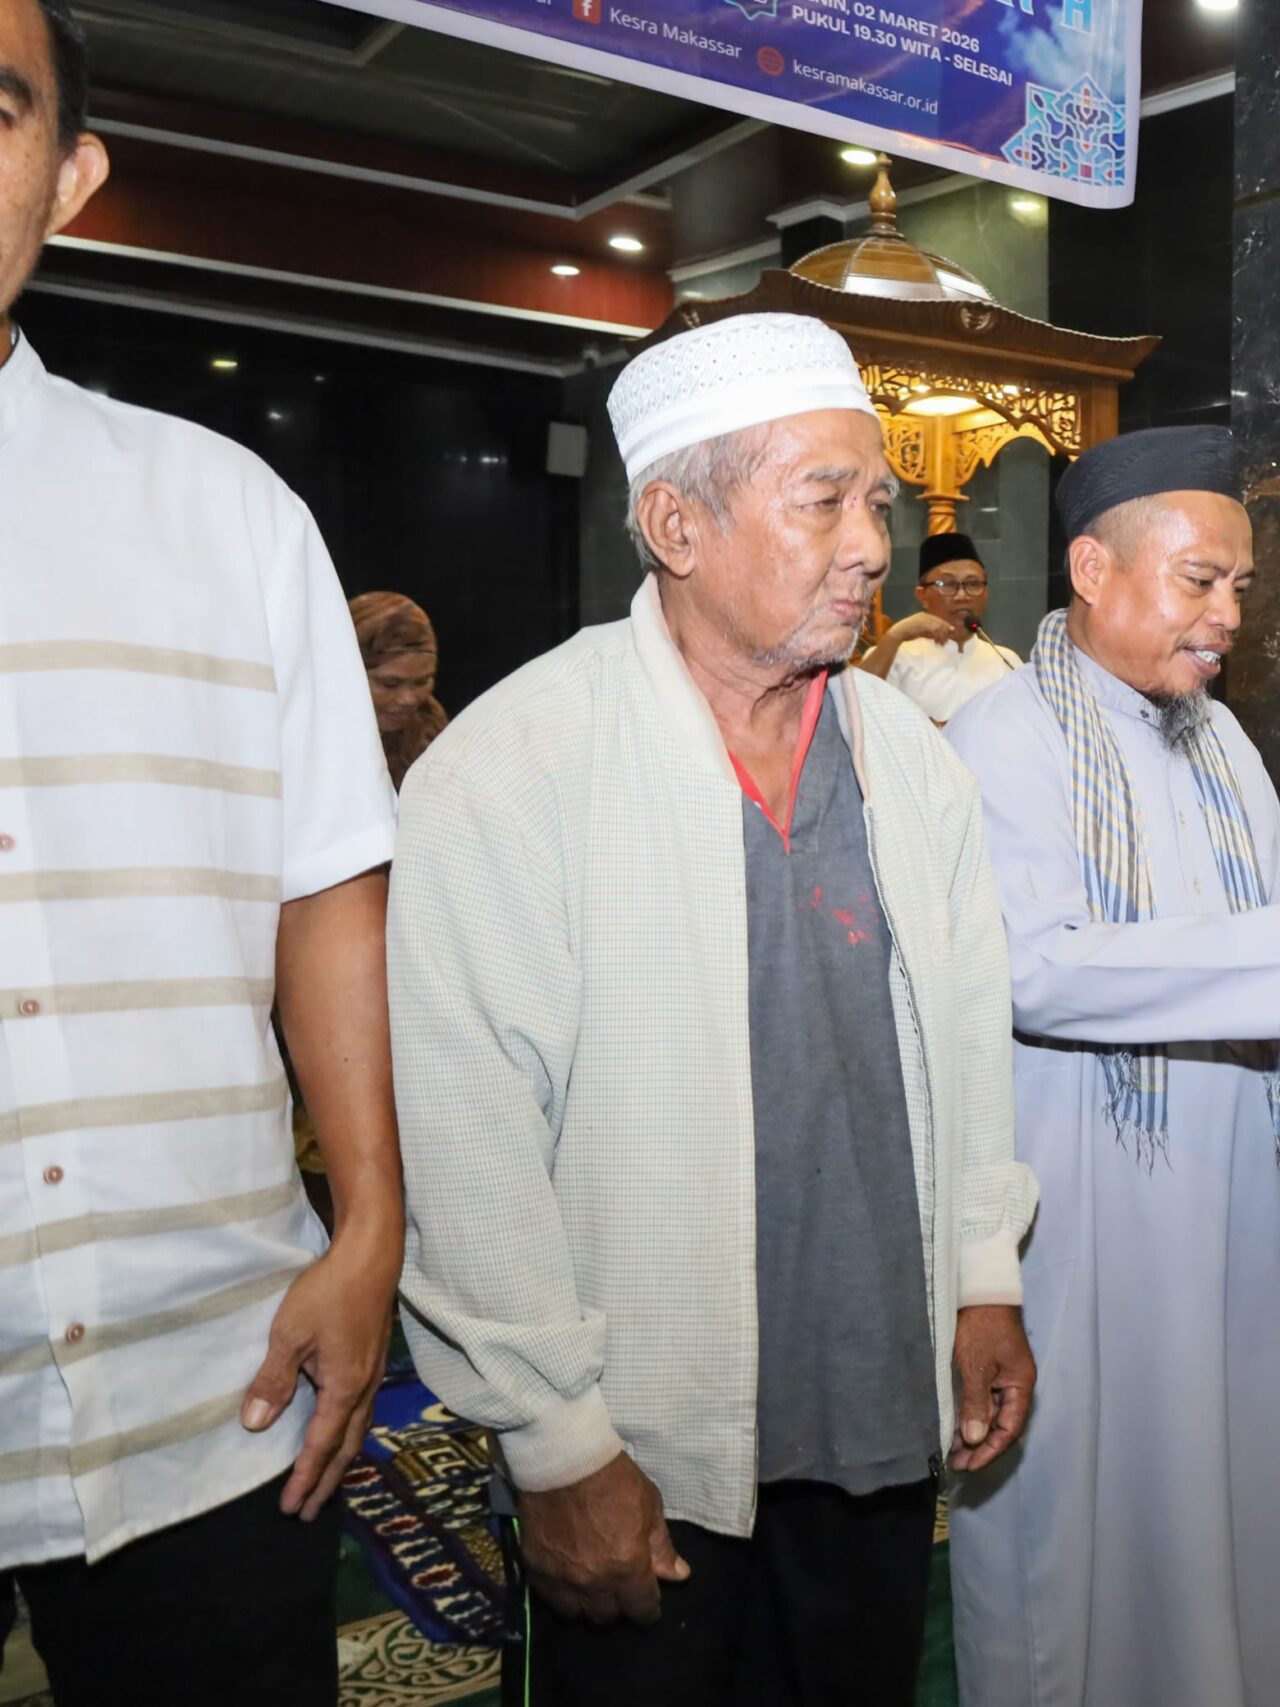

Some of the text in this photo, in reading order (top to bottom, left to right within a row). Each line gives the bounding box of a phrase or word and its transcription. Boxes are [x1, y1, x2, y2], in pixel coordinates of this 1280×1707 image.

[610, 7, 742, 58] Kesra Makassar
[792, 4, 851, 35] PUKUL
[854, 24, 897, 48] 19.30
[901, 36, 941, 63] WITA
[953, 55, 1012, 86] SELESAI
[854, 2, 876, 22] 02
[880, 9, 938, 40] MARET
[941, 26, 980, 53] 2026
[793, 59, 939, 115] kesramakassar.or.id
